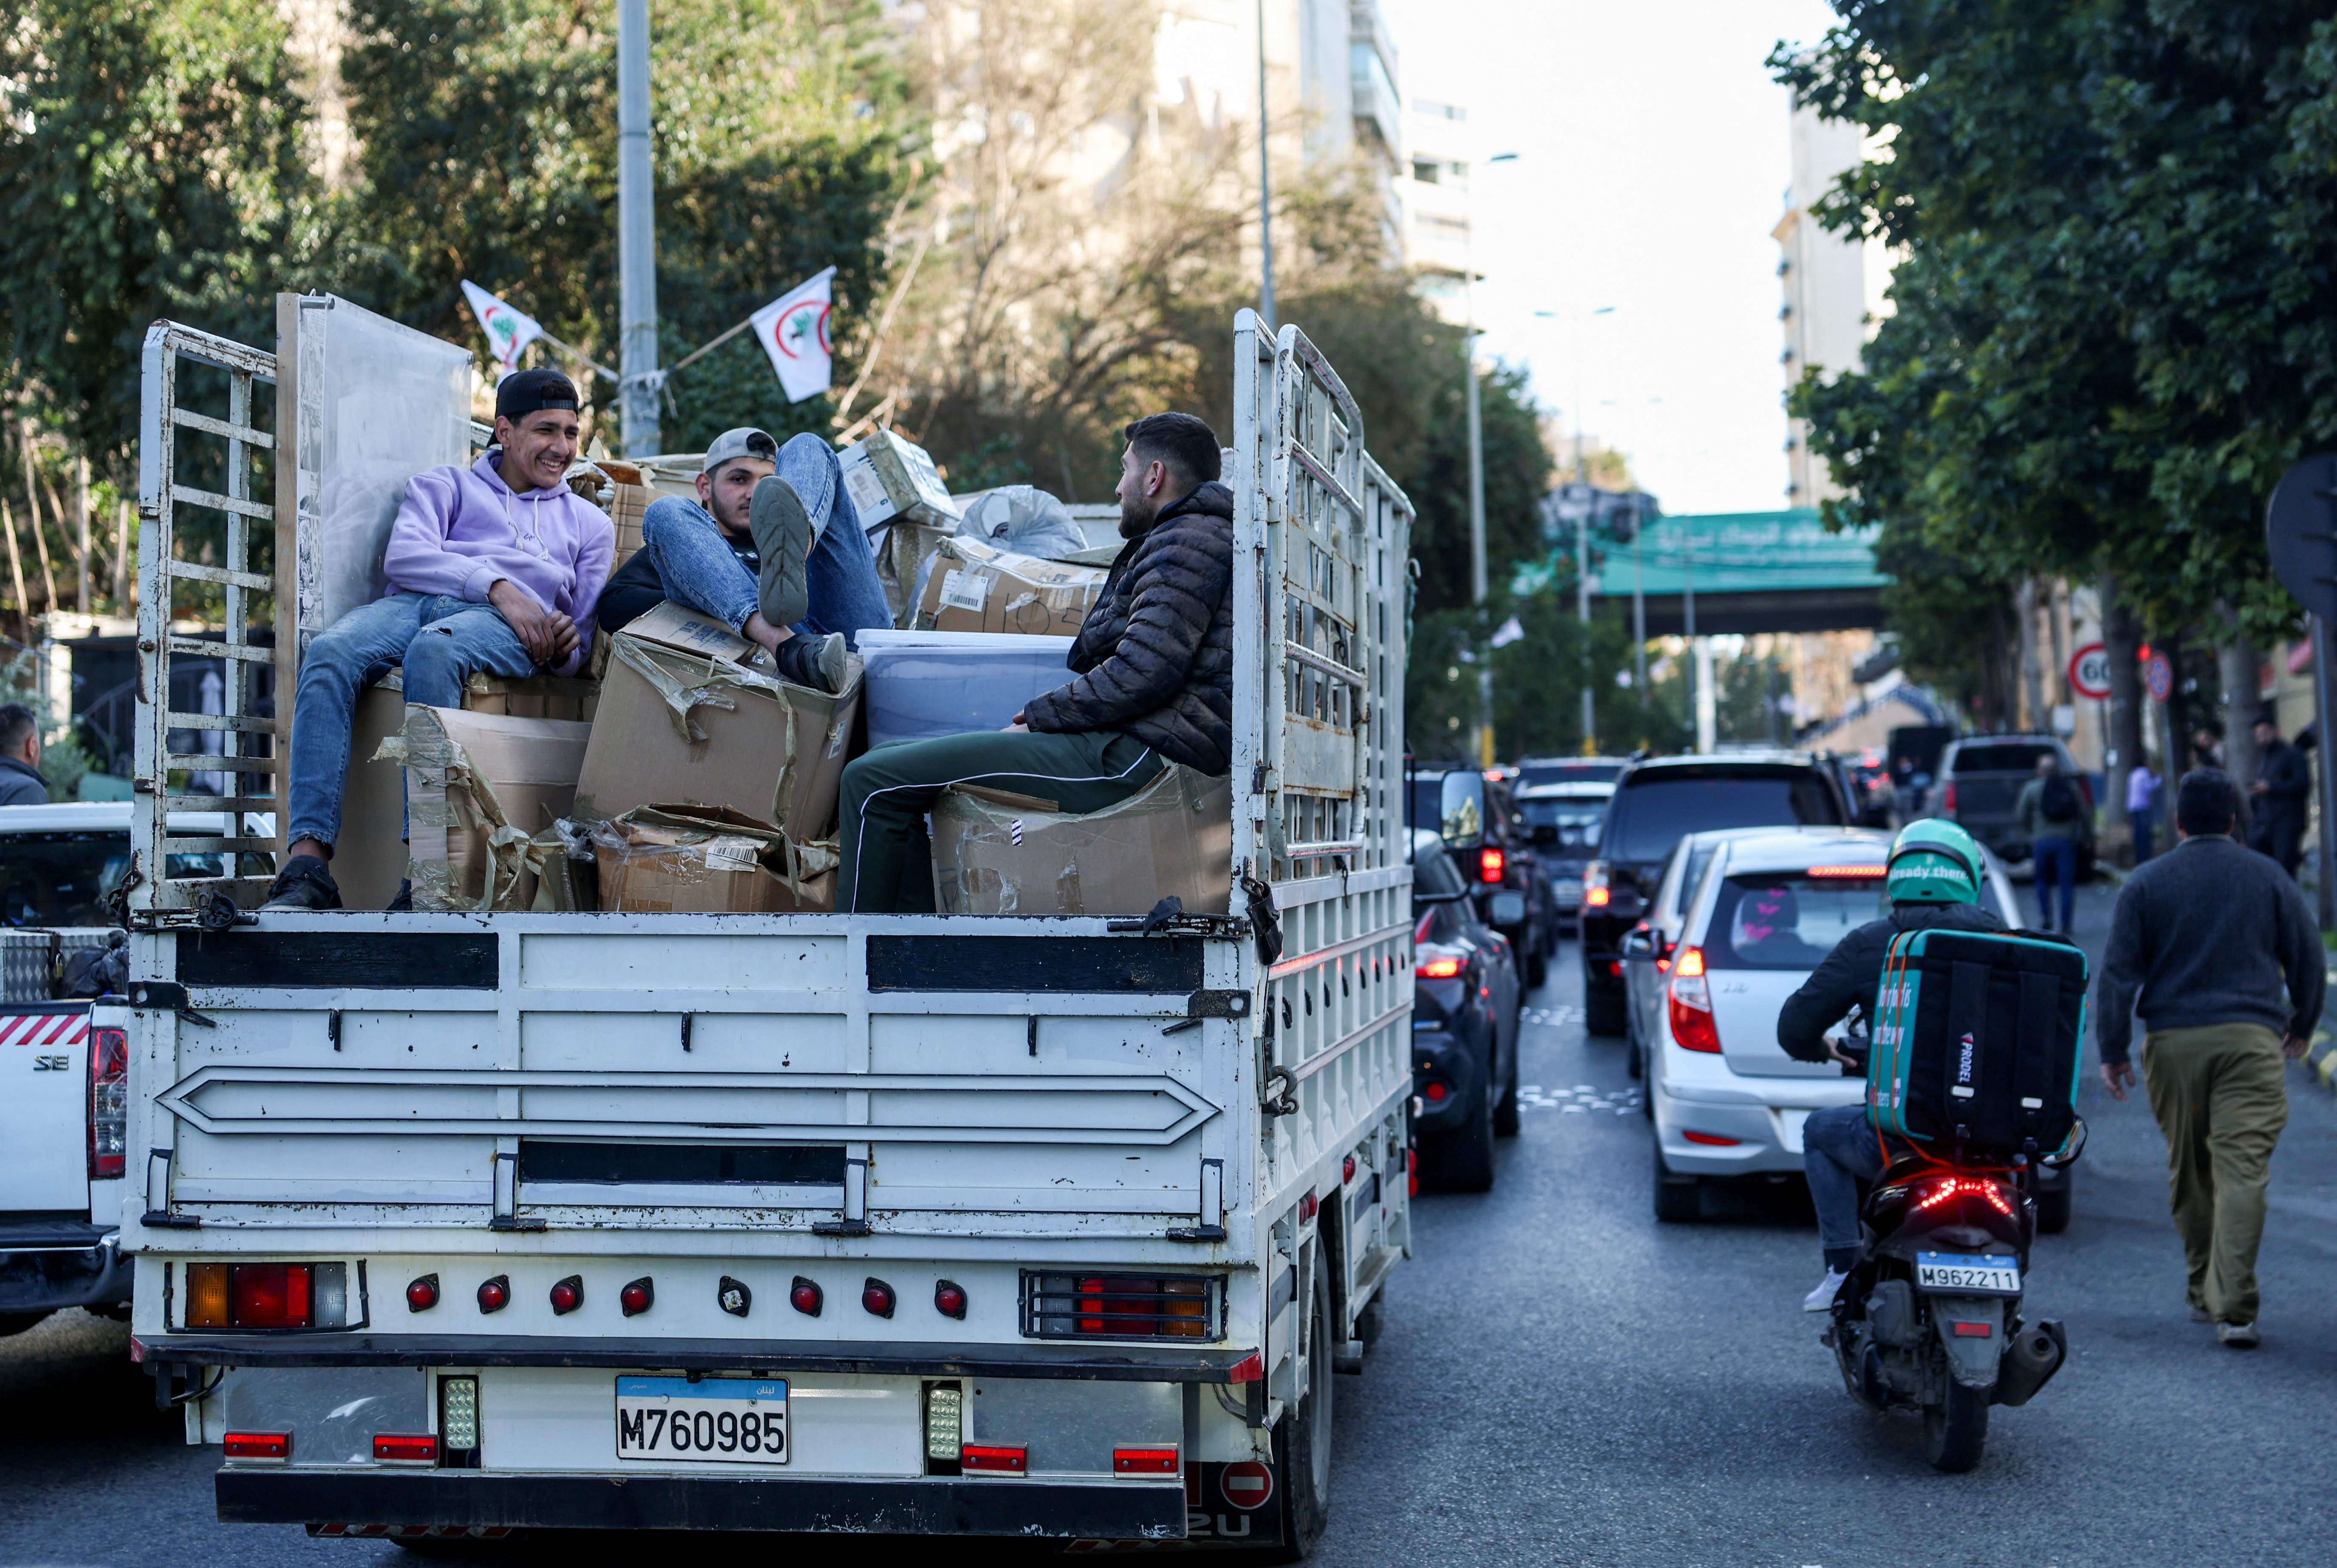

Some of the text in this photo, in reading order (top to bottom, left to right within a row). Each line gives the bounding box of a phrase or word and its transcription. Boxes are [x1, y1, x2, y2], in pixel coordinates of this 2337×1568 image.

[33, 1054, 69, 1070] SE
[1958, 1042, 1973, 1083] PRODEL
[1922, 1268, 2013, 1288] M962211
[756, 1386, 775, 1396] لبنان
[620, 1408, 784, 1454] M760985
